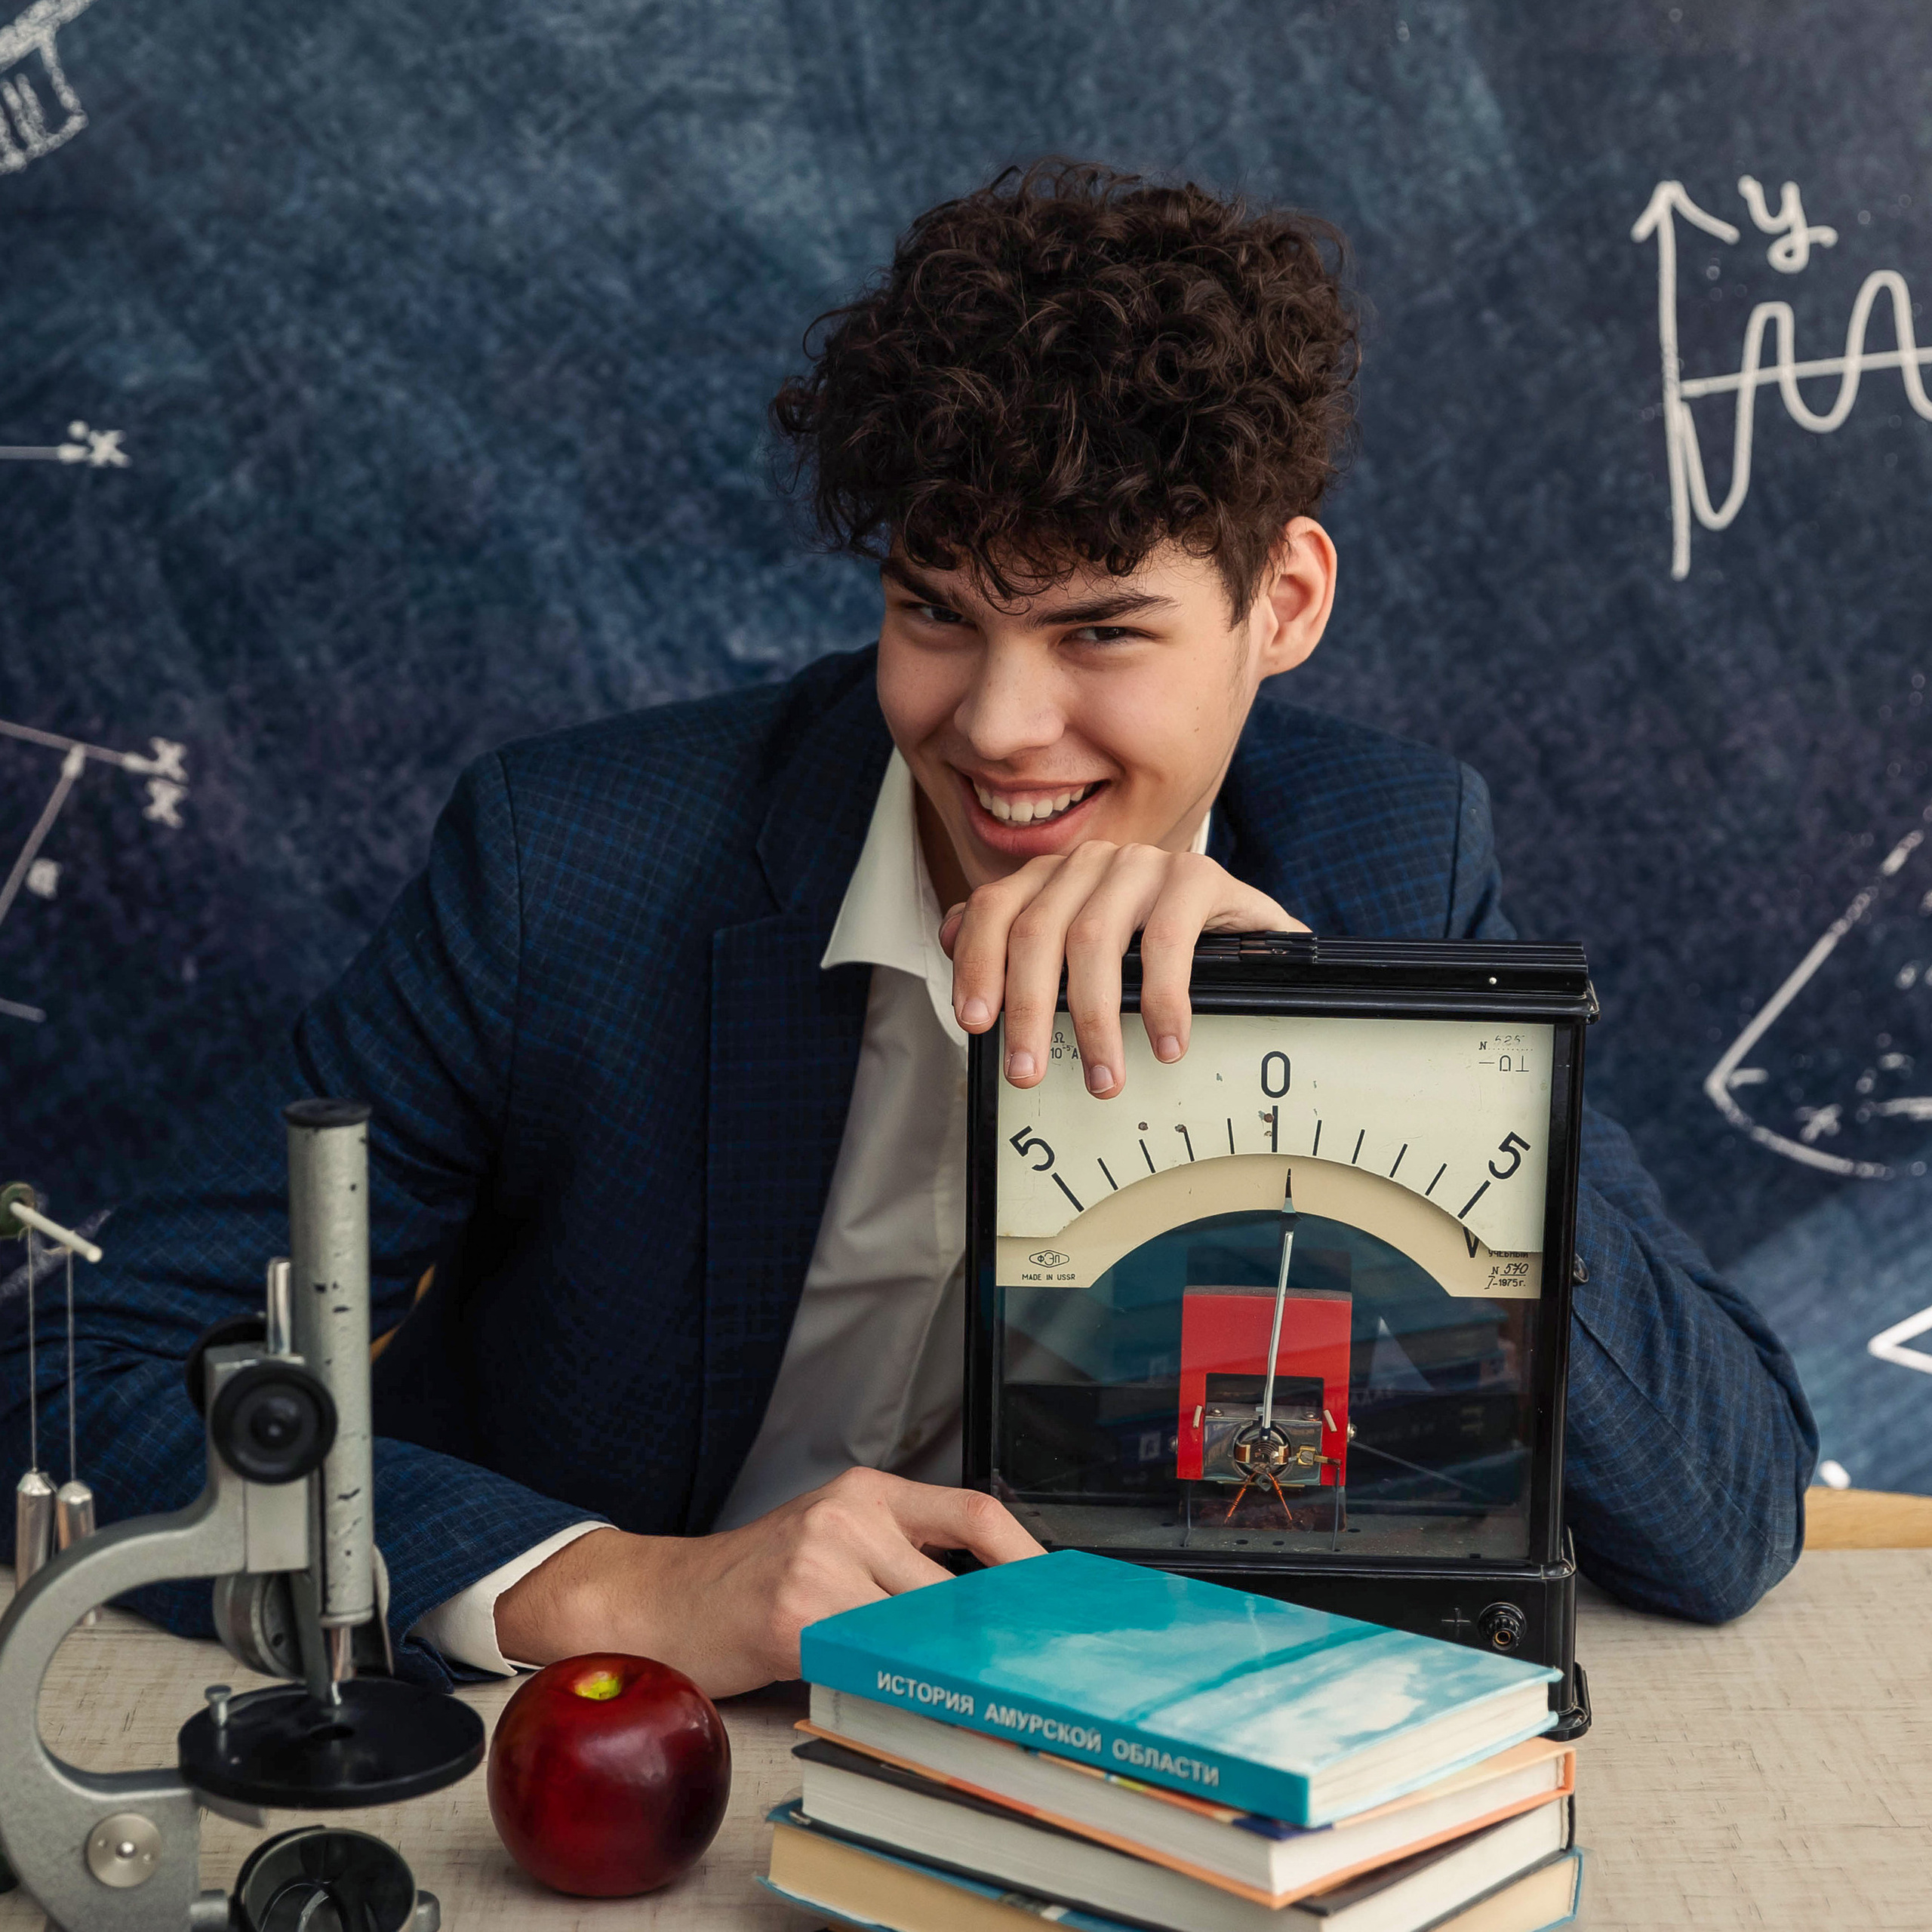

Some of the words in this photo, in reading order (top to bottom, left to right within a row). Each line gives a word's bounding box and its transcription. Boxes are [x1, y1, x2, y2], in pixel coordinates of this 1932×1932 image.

[1261, 1051, 1291, 1099] 0
[1009, 1125, 1056, 1172] 5
[1488, 1131, 1531, 1180] 5
[876, 1670, 974, 1717] ИСТОРИЯ
[984, 1702, 1103, 1753] АМУРСКОЙ
[1111, 1737, 1220, 1787] ОБЛАСТИ
